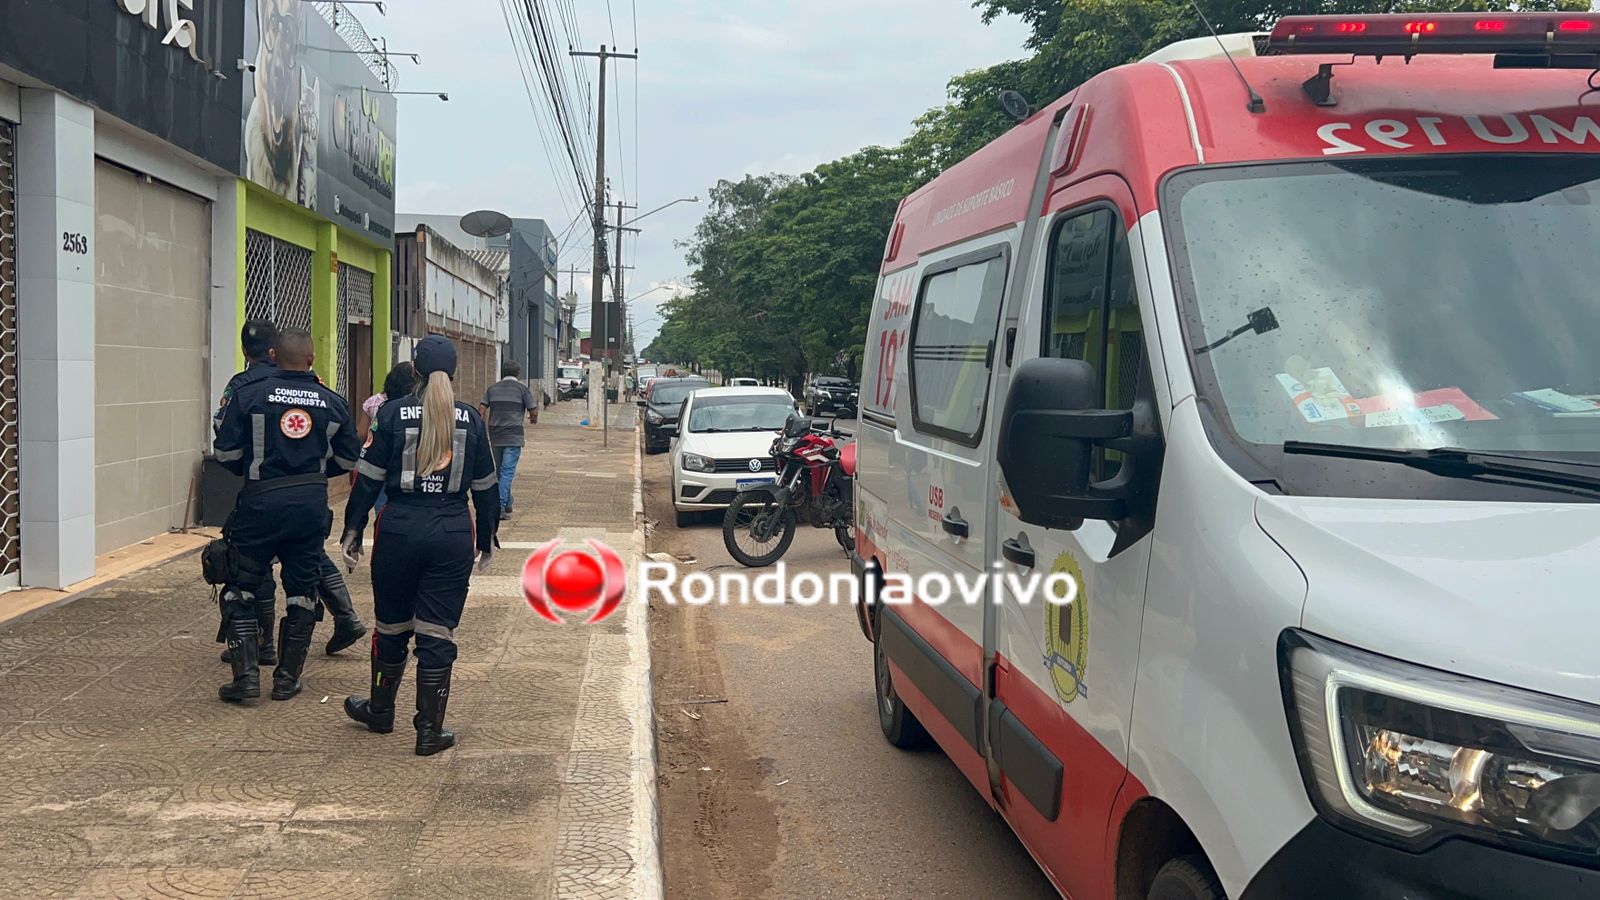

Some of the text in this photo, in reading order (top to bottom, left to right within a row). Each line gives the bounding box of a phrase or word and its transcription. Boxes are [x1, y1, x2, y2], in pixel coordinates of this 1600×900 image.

[964, 189, 989, 212] SUPORTE
[63, 232, 87, 254] 2563
[885, 272, 915, 320] SAM
[876, 329, 906, 411] 19
[269, 394, 327, 408] SOCORRISTA
[275, 388, 319, 399] CONDUTOR
[400, 406, 470, 423] ENFRA
[421, 482, 443, 493] 192
[422, 474, 444, 482] SAMU
[929, 485, 944, 508] USB
